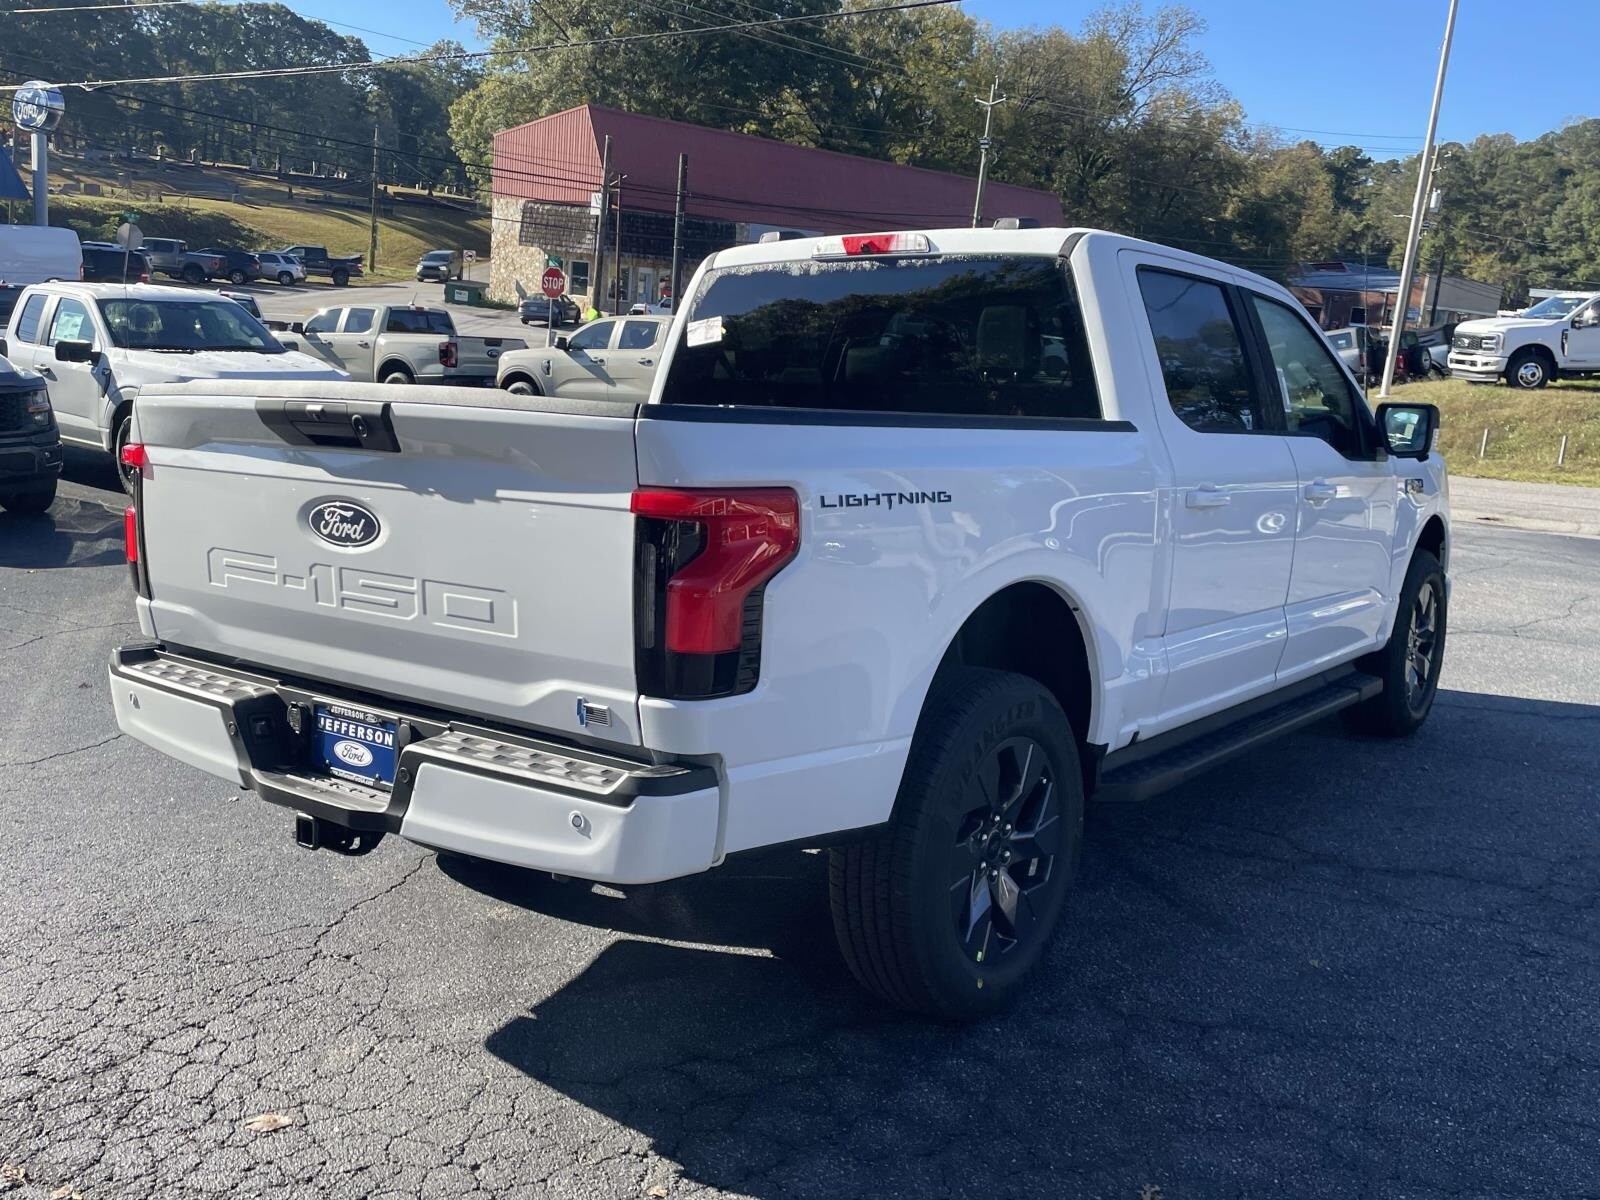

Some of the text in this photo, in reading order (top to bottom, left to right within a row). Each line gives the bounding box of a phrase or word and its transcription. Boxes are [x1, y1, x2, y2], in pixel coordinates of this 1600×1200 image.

[17, 91, 39, 119] Ford
[543, 276, 563, 289] STOP
[820, 491, 952, 511] LIGHTNING
[320, 507, 365, 540] Ford
[207, 547, 518, 638] F-150
[330, 705, 365, 720] JEFFERSON
[319, 717, 393, 746] JEFFERSON
[341, 744, 365, 763] Ford
